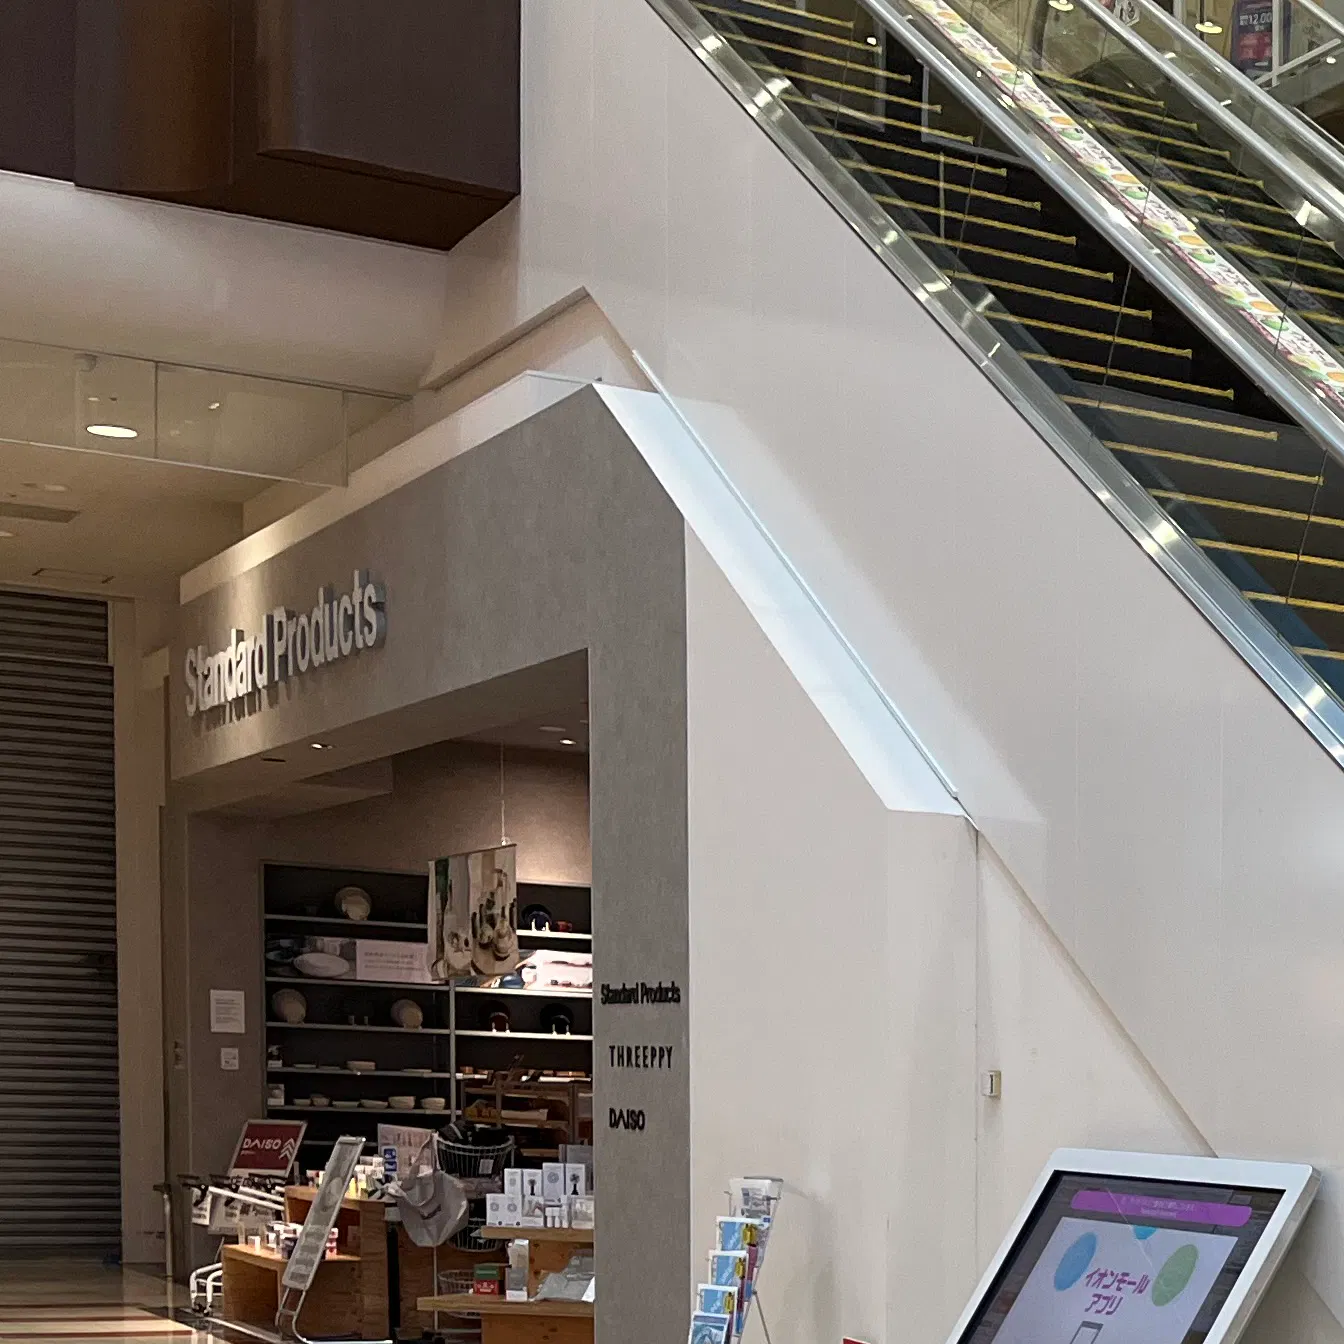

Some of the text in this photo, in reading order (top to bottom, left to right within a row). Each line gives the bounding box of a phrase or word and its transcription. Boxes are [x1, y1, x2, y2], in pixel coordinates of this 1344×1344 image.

[185, 569, 382, 717] Standard Products
[601, 981, 681, 1005] Standard Products
[609, 1045, 673, 1069] THREEPPY
[609, 1107, 646, 1131] DAISO
[243, 1138, 281, 1150] DAISO
[1086, 1267, 1150, 1294] イオンモール
[1084, 1293, 1124, 1315] アプリ
